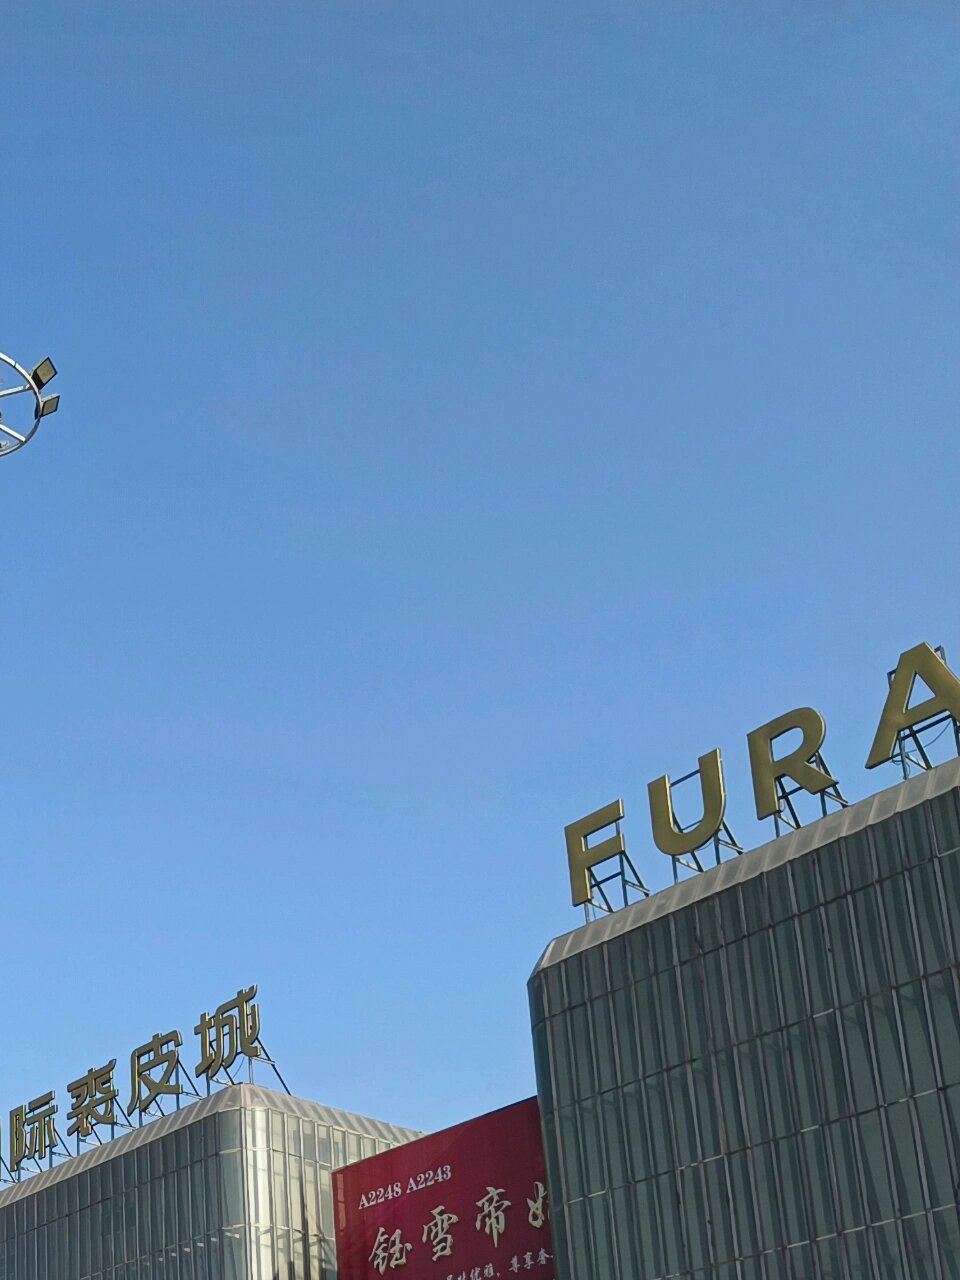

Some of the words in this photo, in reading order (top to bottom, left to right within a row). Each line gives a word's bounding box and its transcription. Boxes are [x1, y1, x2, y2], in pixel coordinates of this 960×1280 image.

[564, 641, 960, 907] FURA
[358, 1182, 402, 1210] A2248
[406, 1165, 452, 1194] A2243
